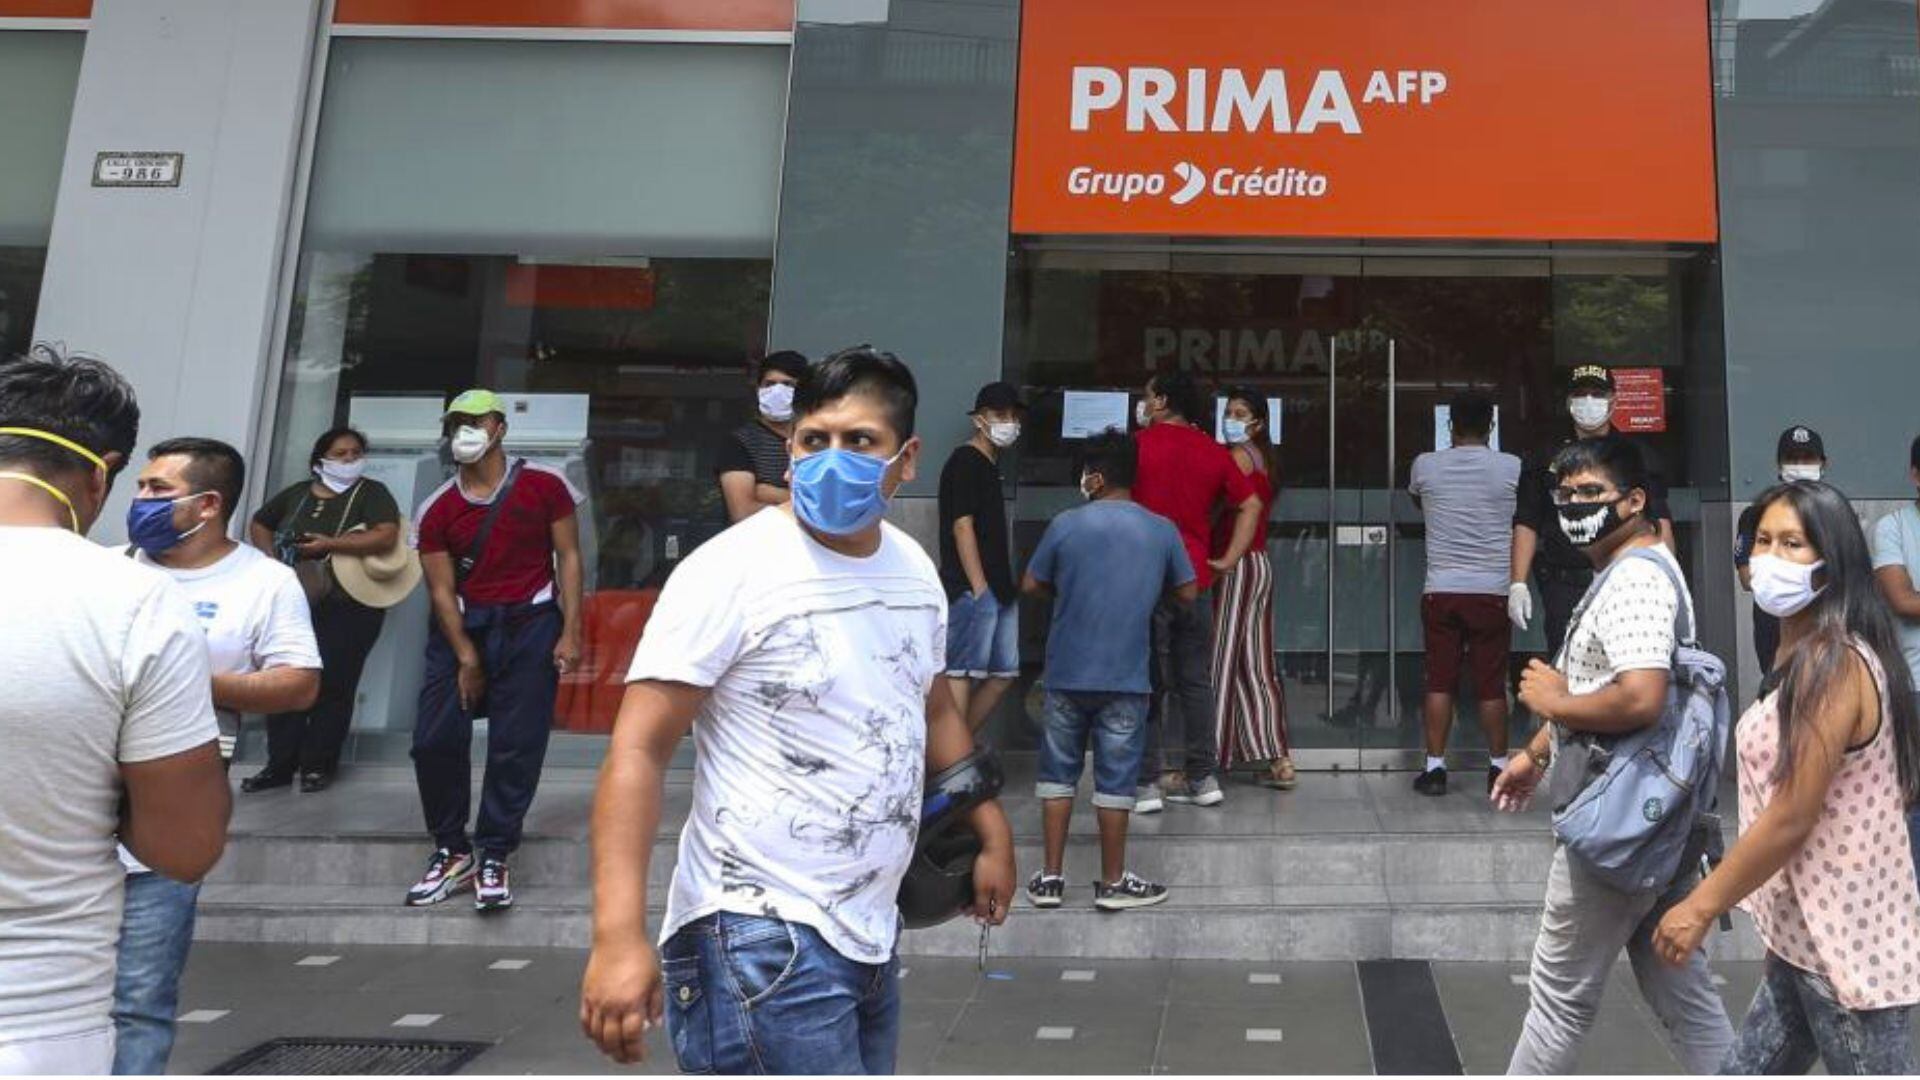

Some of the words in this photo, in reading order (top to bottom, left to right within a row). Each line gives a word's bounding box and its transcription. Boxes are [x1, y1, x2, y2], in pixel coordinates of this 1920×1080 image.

[1070, 66, 1362, 134] PRIMA
[1363, 70, 1448, 105] AFP
[1067, 166, 1165, 202] Grupo
[1212, 166, 1328, 197] Crédito
[1143, 327, 1329, 372] PRIMA
